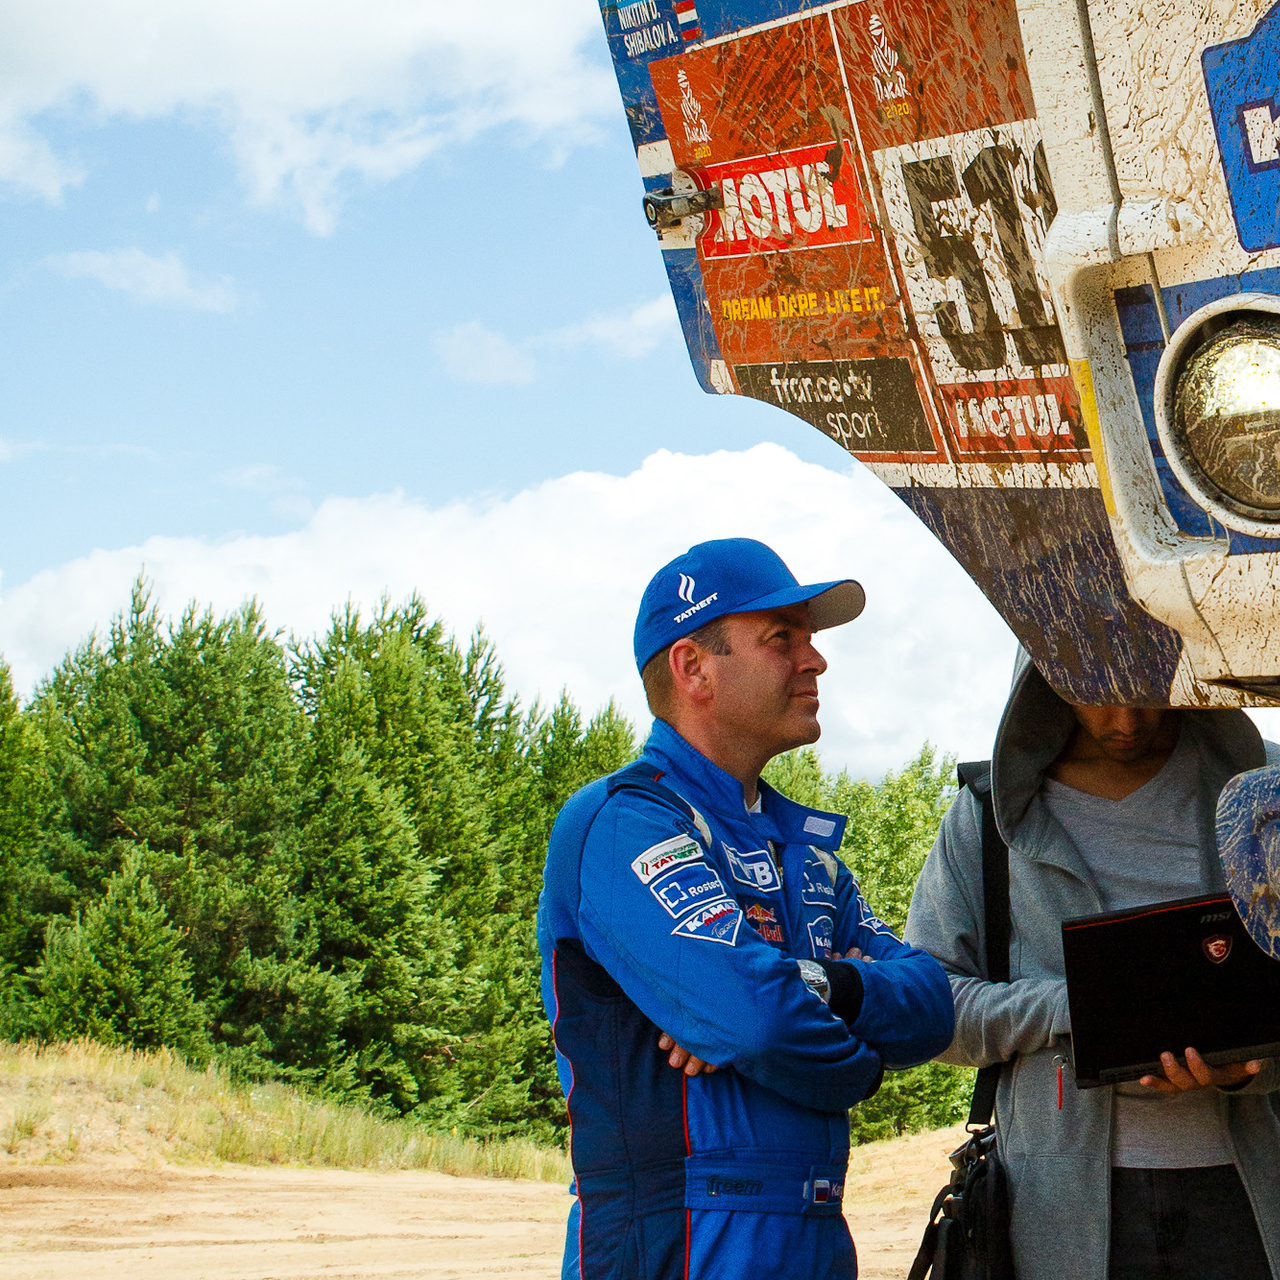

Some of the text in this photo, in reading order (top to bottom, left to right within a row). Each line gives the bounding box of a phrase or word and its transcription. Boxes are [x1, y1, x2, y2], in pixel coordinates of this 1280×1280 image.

[617, 0, 651, 31] NIKITIN
[623, 20, 679, 58] SHIBALOV A.
[873, 70, 911, 103] DAKAR
[713, 161, 849, 243] MOTUL
[722, 296, 777, 321] DREAM.
[956, 393, 1070, 439] MOTUL
[673, 592, 718, 624] TATNEFT
[651, 846, 699, 869] TATNEFT
[688, 879, 721, 898] Rostec
[707, 1175, 762, 1196] freem
